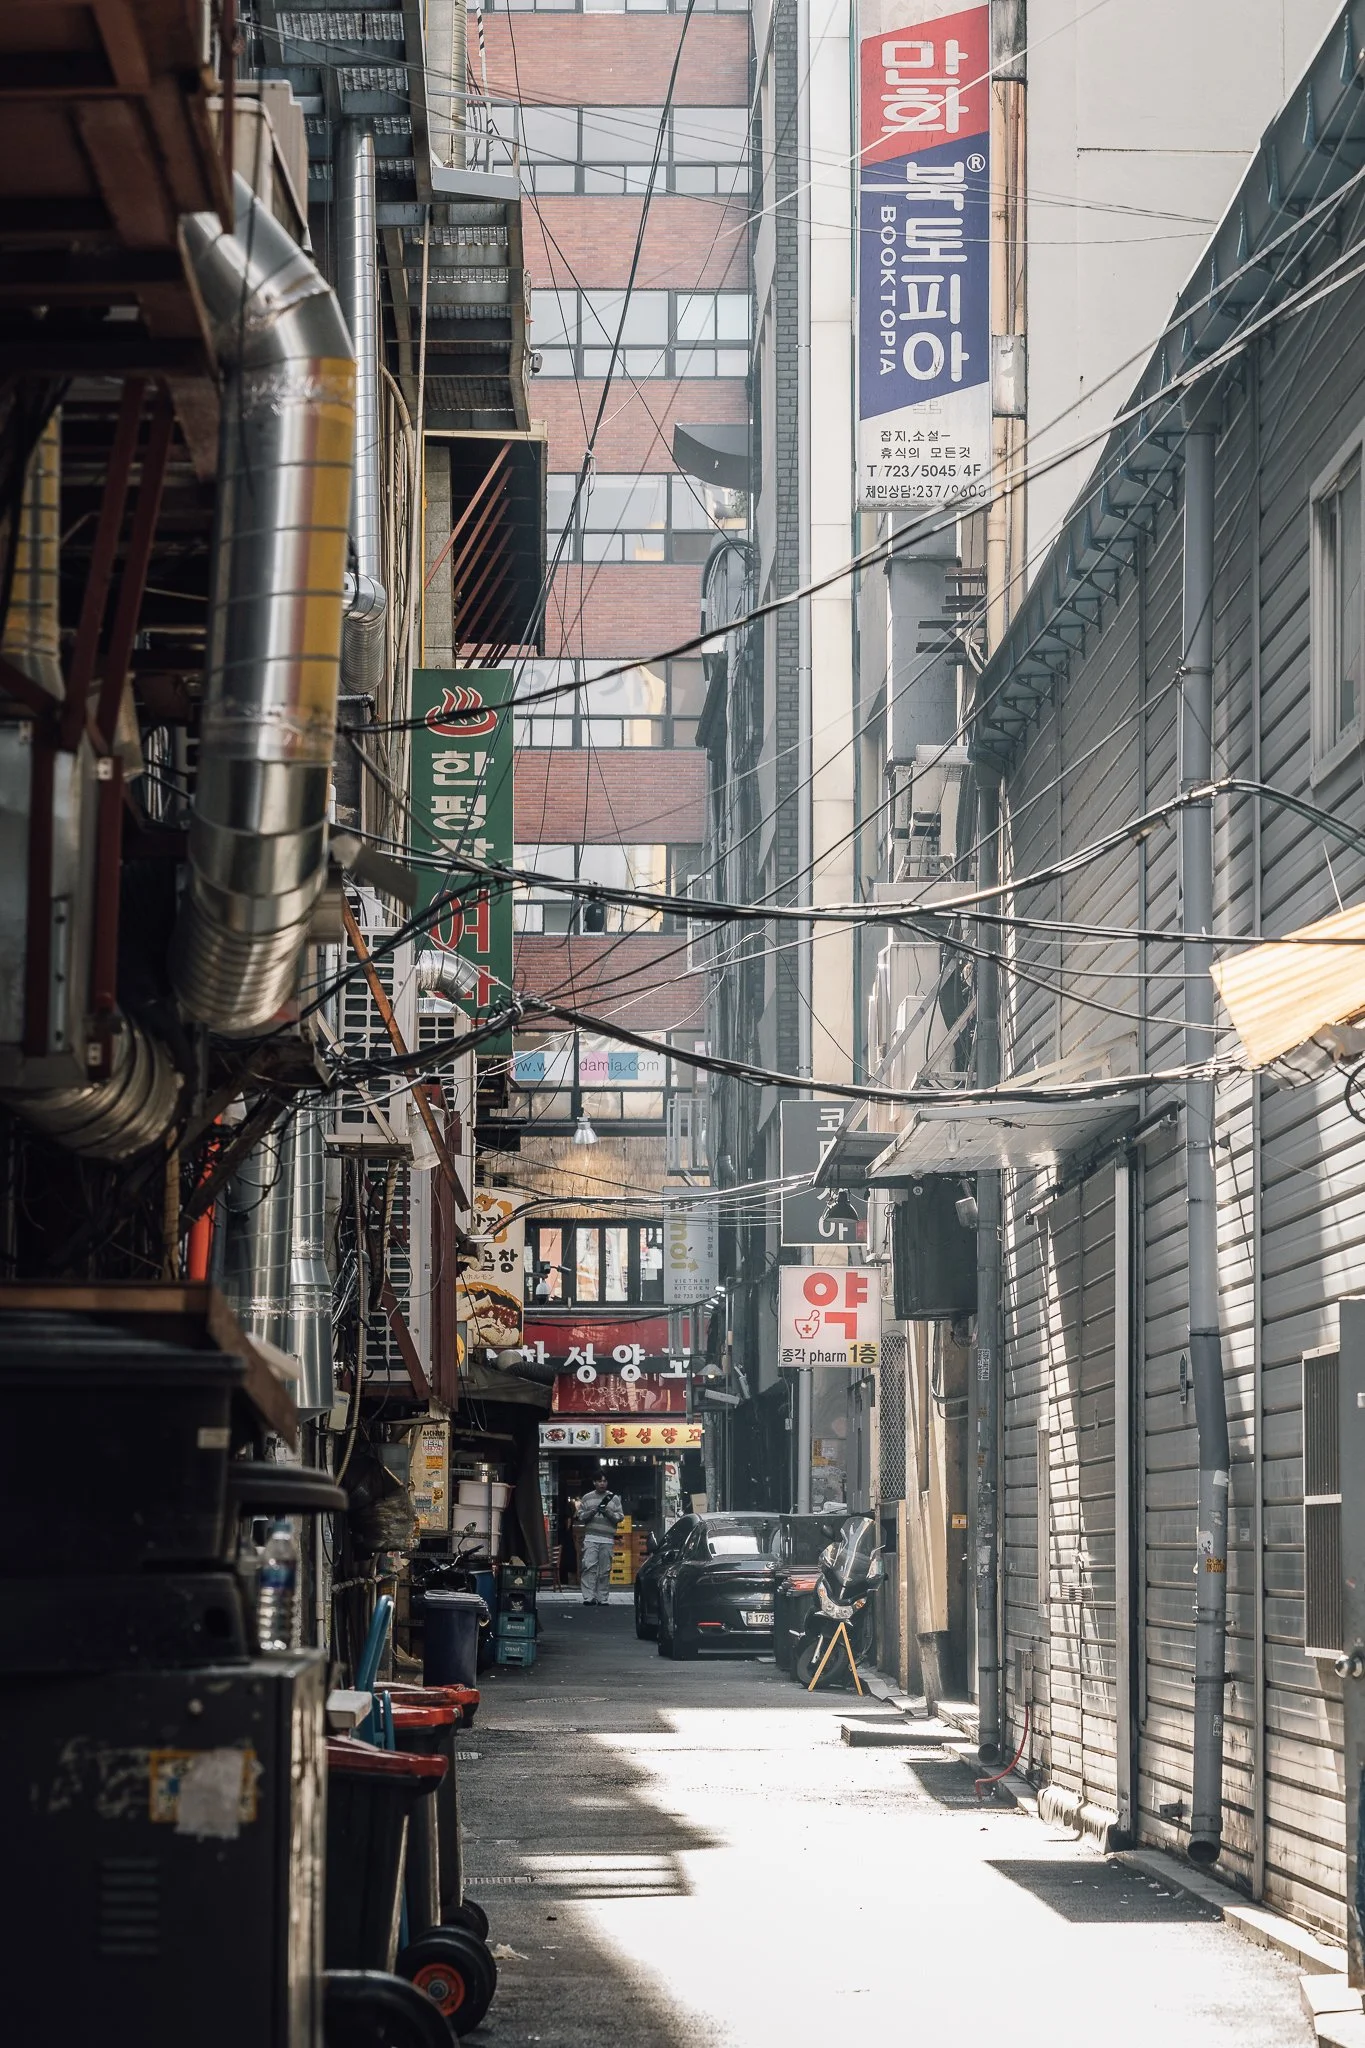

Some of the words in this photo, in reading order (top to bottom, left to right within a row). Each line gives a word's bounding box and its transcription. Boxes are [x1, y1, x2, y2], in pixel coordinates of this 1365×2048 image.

[881, 39, 970, 134] 만화
[860, 161, 970, 383] 북토피아
[880, 204, 897, 376] BOOKTOPIA
[880, 447, 920, 459] 휴식의
[930, 446, 971, 459] 모든것
[803, 1271, 868, 1340] 약
[782, 1348, 806, 1363] 종각
[809, 1349, 847, 1365] pharm
[849, 1343, 877, 1365] 1층
